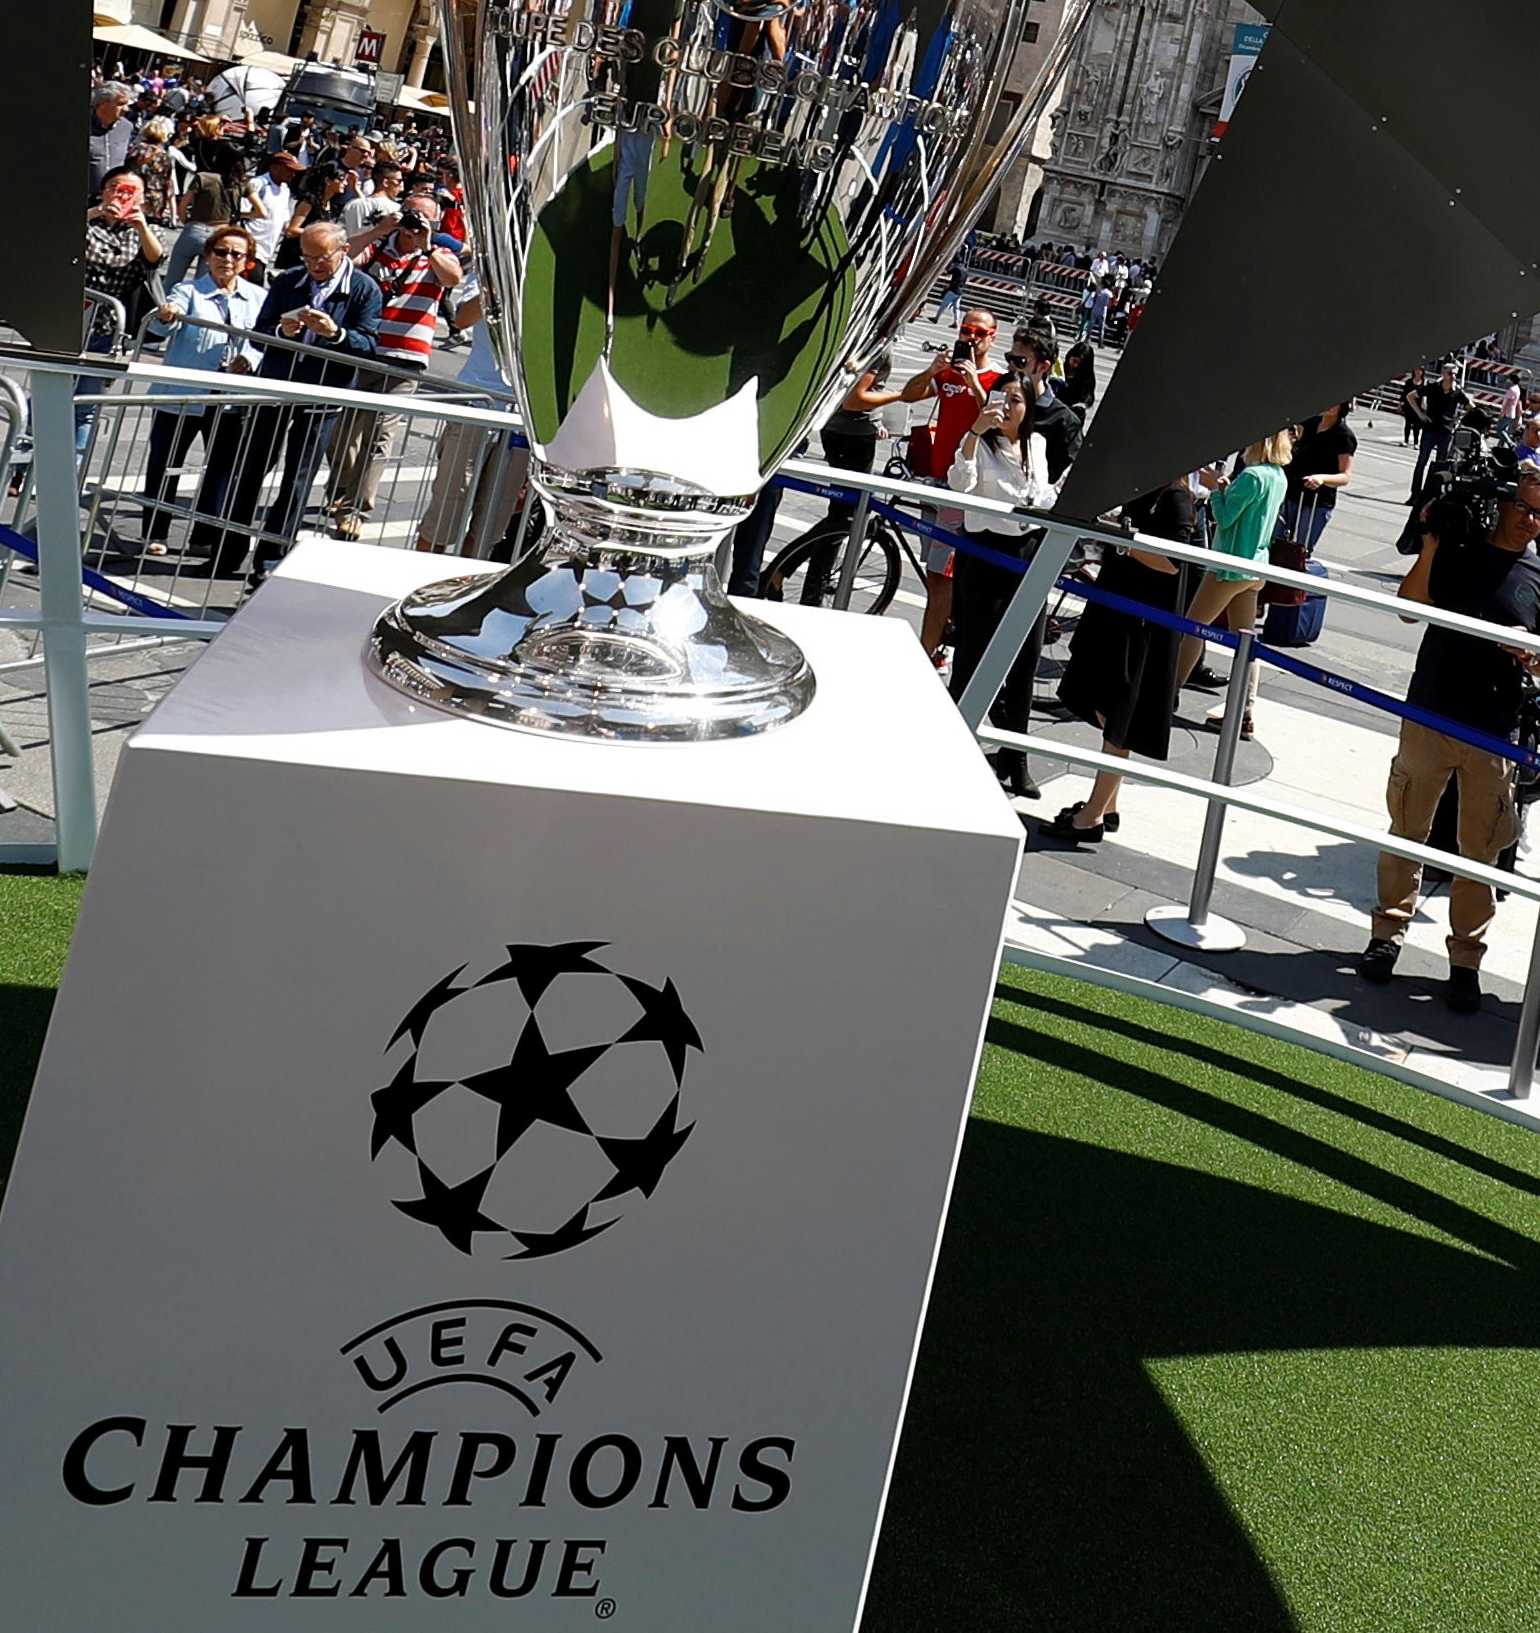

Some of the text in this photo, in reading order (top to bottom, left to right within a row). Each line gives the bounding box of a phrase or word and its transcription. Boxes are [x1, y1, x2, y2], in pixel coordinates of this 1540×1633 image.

[358, 36, 377, 57] M
[572, 20, 646, 65] DES
[653, 35, 786, 95] CLUBS
[1201, 627, 1224, 642] RESPECT
[1327, 676, 1354, 693] RESPECT
[352, 1316, 578, 1405] UEFA
[61, 1416, 797, 1513] CHAMPIONS
[230, 1537, 608, 1599] LEAGUE
